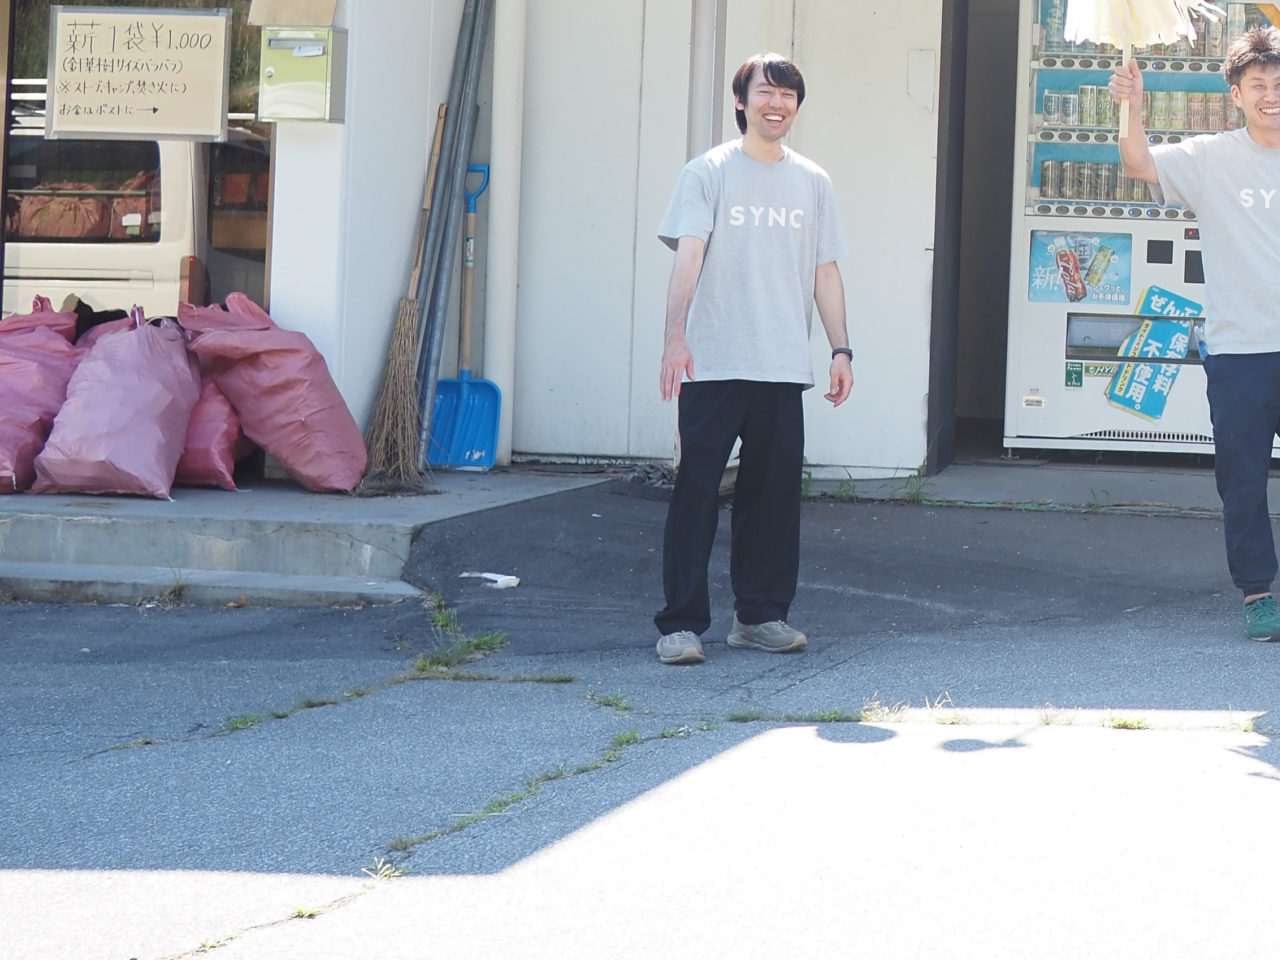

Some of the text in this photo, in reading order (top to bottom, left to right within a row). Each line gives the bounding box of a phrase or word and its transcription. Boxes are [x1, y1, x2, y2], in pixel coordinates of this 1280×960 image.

[729, 205, 805, 228] SYNC
[1152, 332, 1189, 396] 保存料
